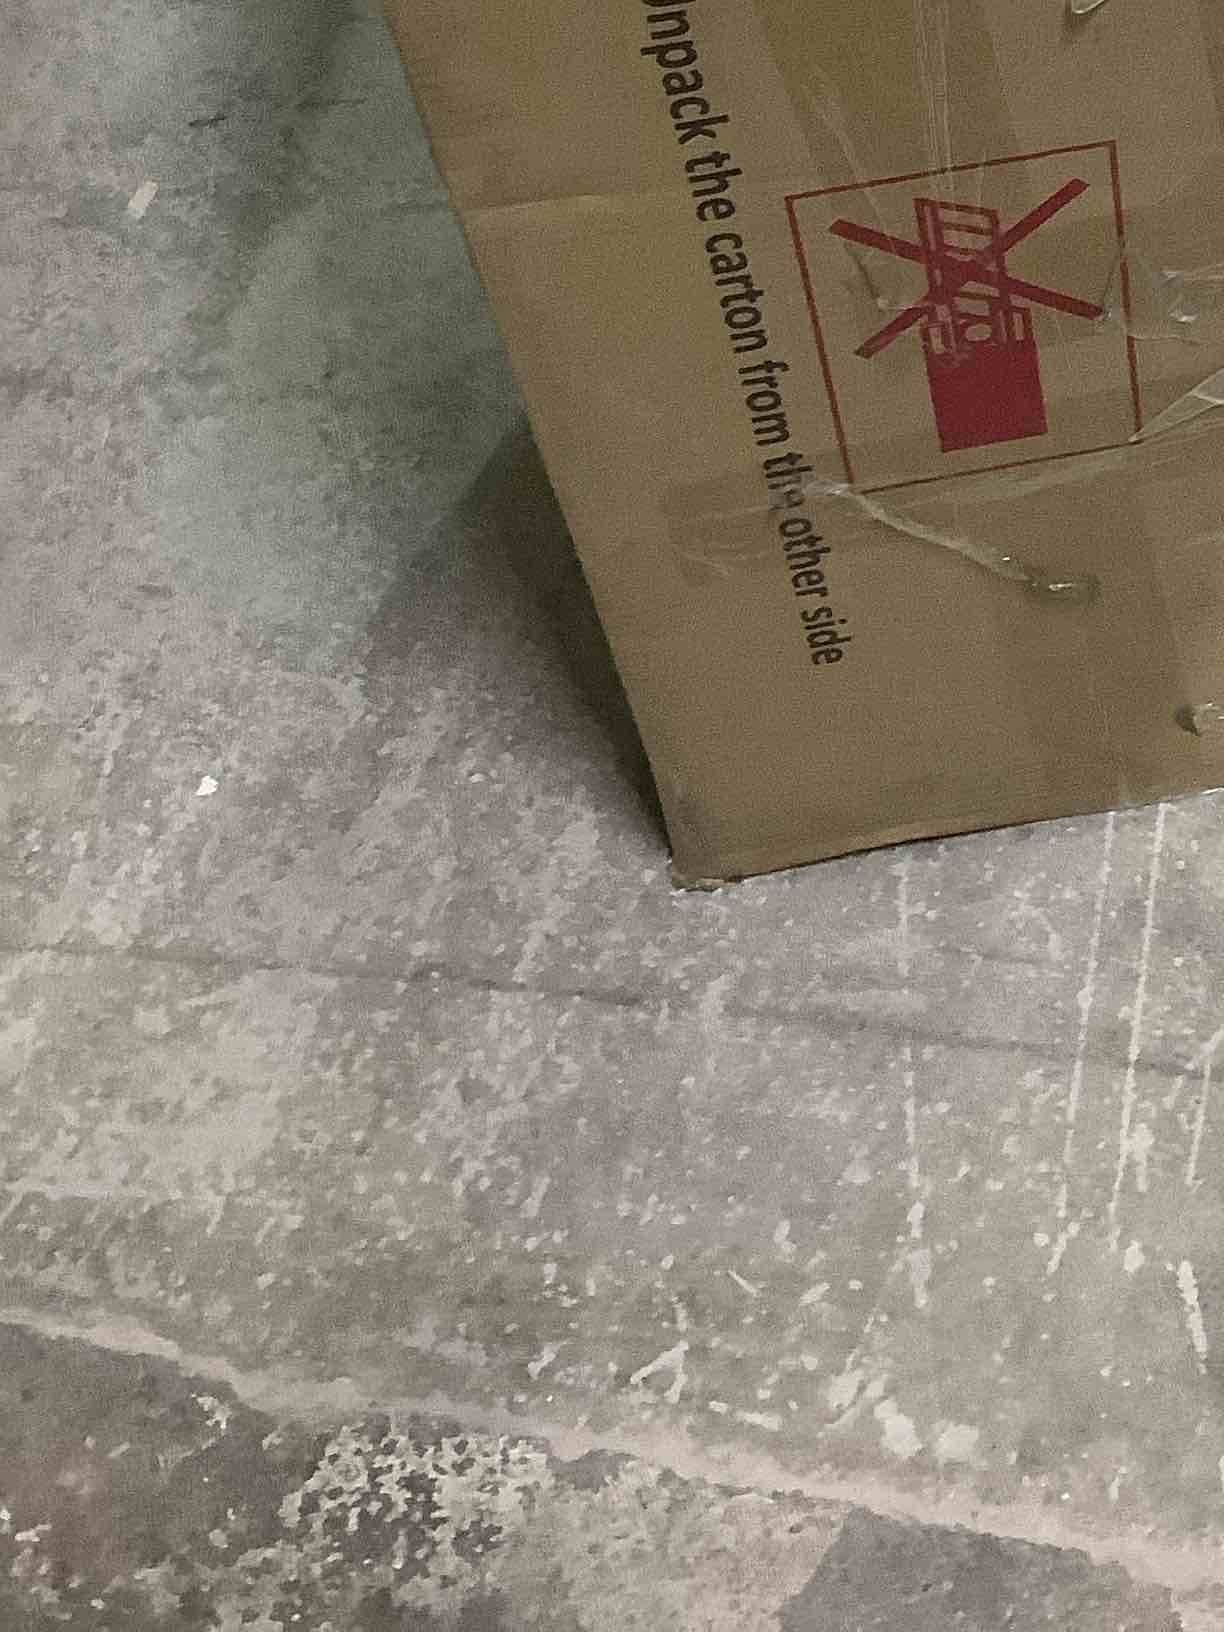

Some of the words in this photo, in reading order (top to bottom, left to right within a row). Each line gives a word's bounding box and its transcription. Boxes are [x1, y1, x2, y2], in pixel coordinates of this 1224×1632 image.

[684, 150, 744, 222] the
[703, 229, 769, 354] carton
[738, 358, 790, 447] from
[763, 452, 814, 512] the
[778, 514, 832, 600] other
[801, 602, 854, 666] side
